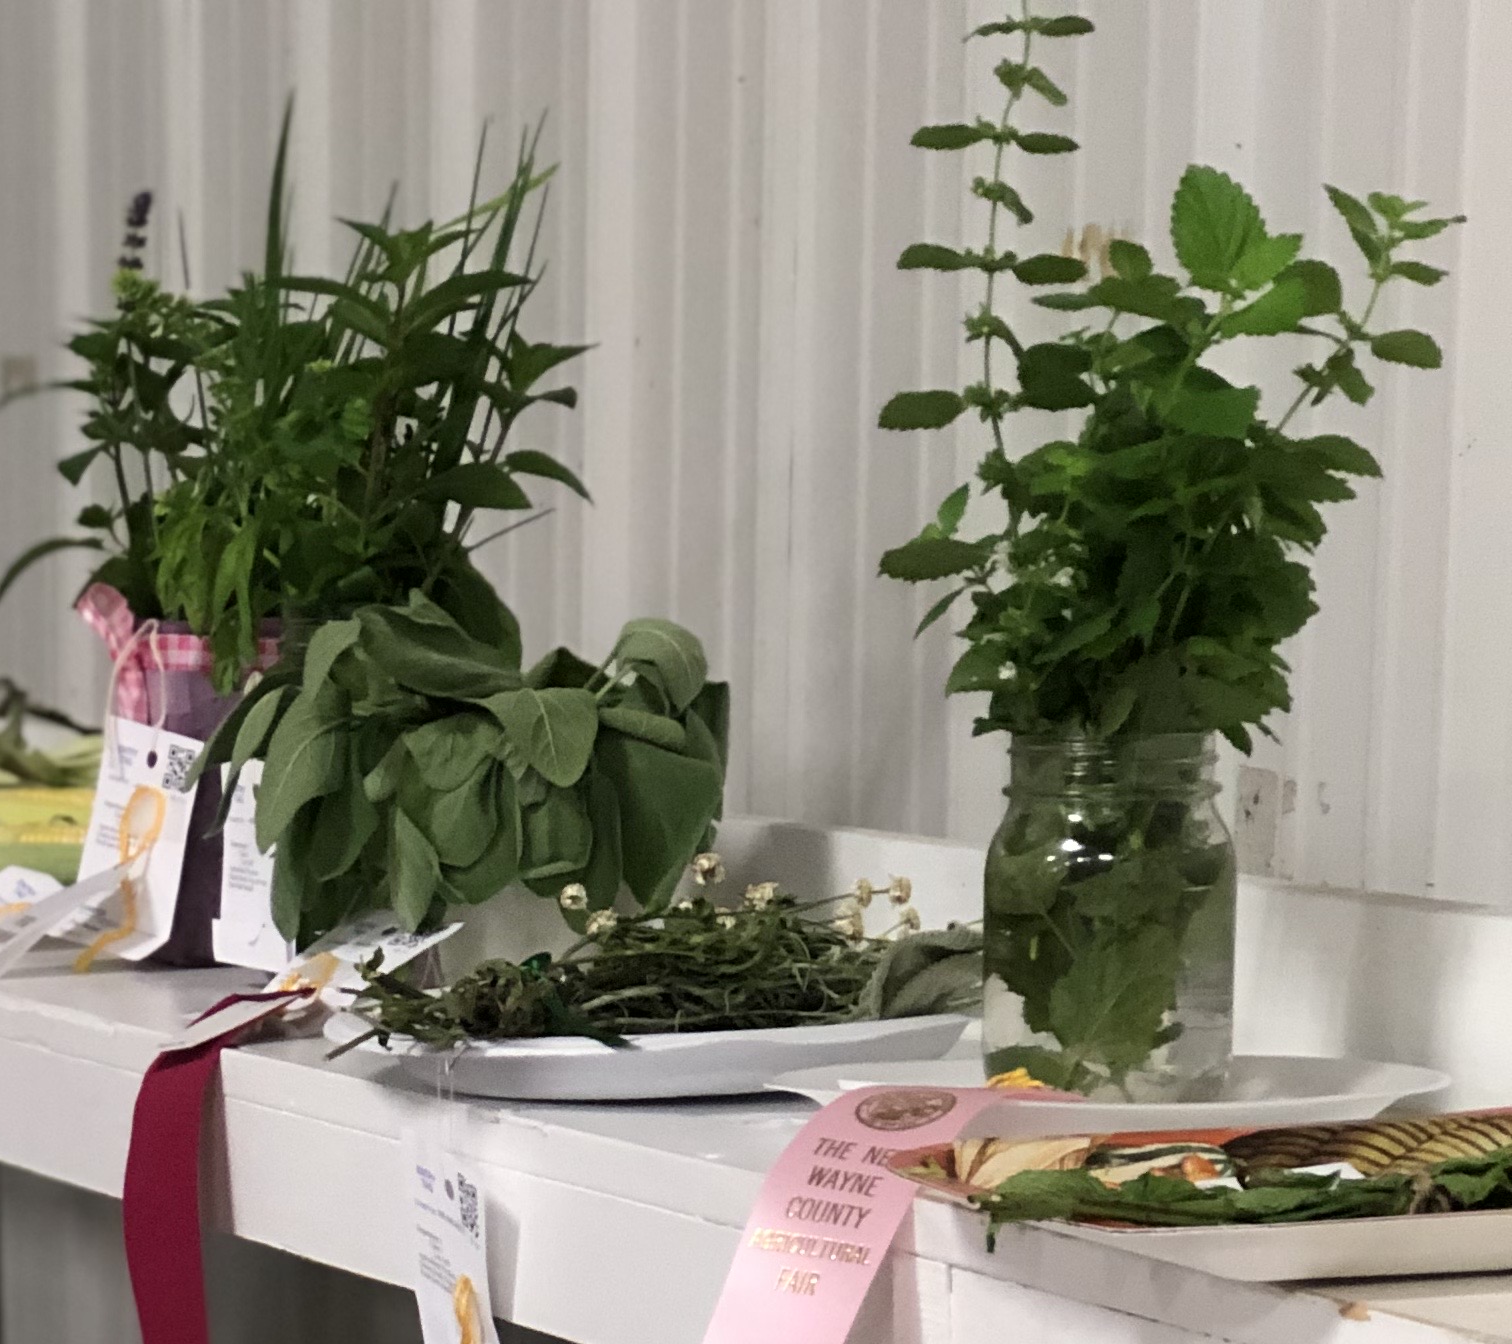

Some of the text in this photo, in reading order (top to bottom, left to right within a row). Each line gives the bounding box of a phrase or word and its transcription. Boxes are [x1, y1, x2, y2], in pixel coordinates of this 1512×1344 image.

[813, 1137, 892, 1168] THE NE
[807, 1165, 884, 1198] WAYNE
[786, 1197, 872, 1228] COUNTY
[776, 1269, 820, 1296] FAIR
